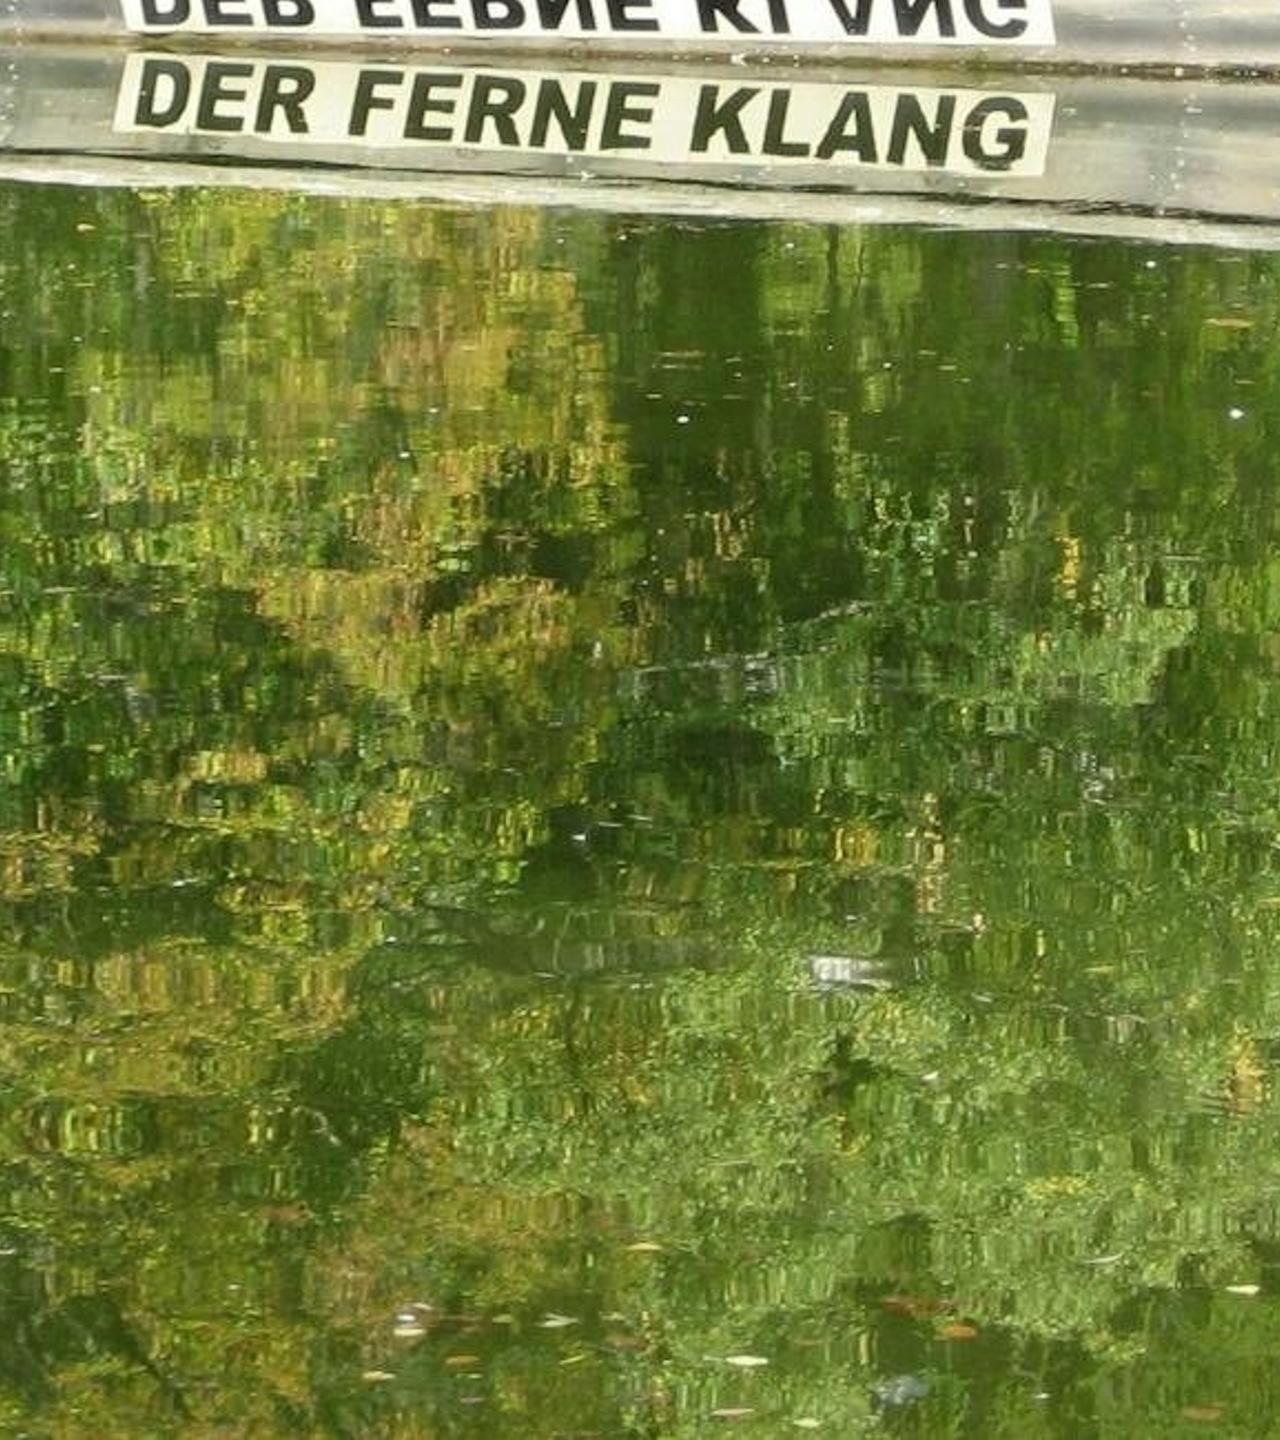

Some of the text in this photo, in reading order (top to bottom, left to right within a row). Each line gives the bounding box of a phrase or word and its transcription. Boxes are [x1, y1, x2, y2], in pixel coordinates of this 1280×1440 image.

[134, 58, 1029, 172] DER FERNE KLANG
